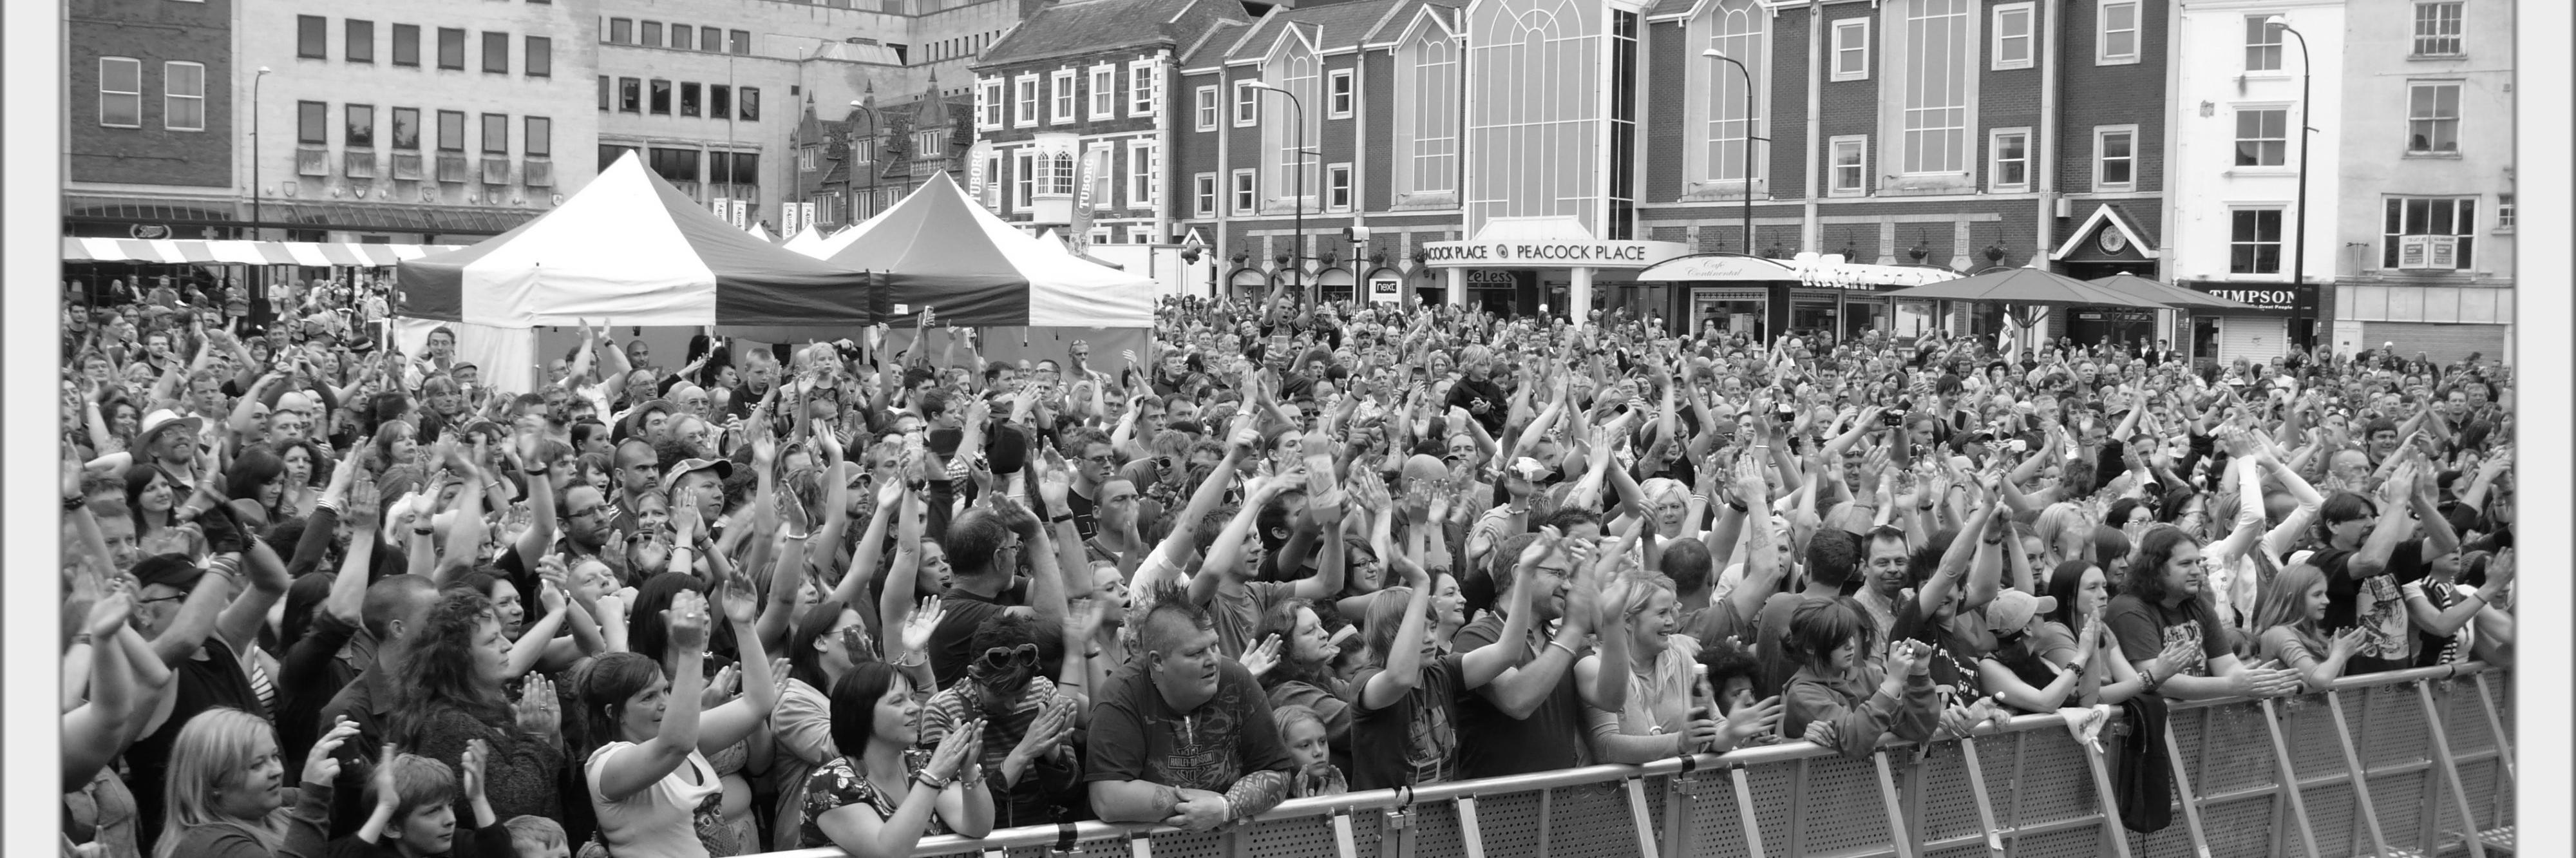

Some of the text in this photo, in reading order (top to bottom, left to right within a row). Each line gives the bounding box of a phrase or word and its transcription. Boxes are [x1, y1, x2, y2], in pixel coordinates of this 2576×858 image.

[969, 150, 983, 201] TUBORG
[1079, 158, 1094, 208] TUBORG
[1455, 245, 1487, 259] PLACE
[1517, 244, 1645, 260] PEACOCK PLACE
[1377, 283, 1396, 291] next
[2210, 289, 2295, 304] TIMPSON
